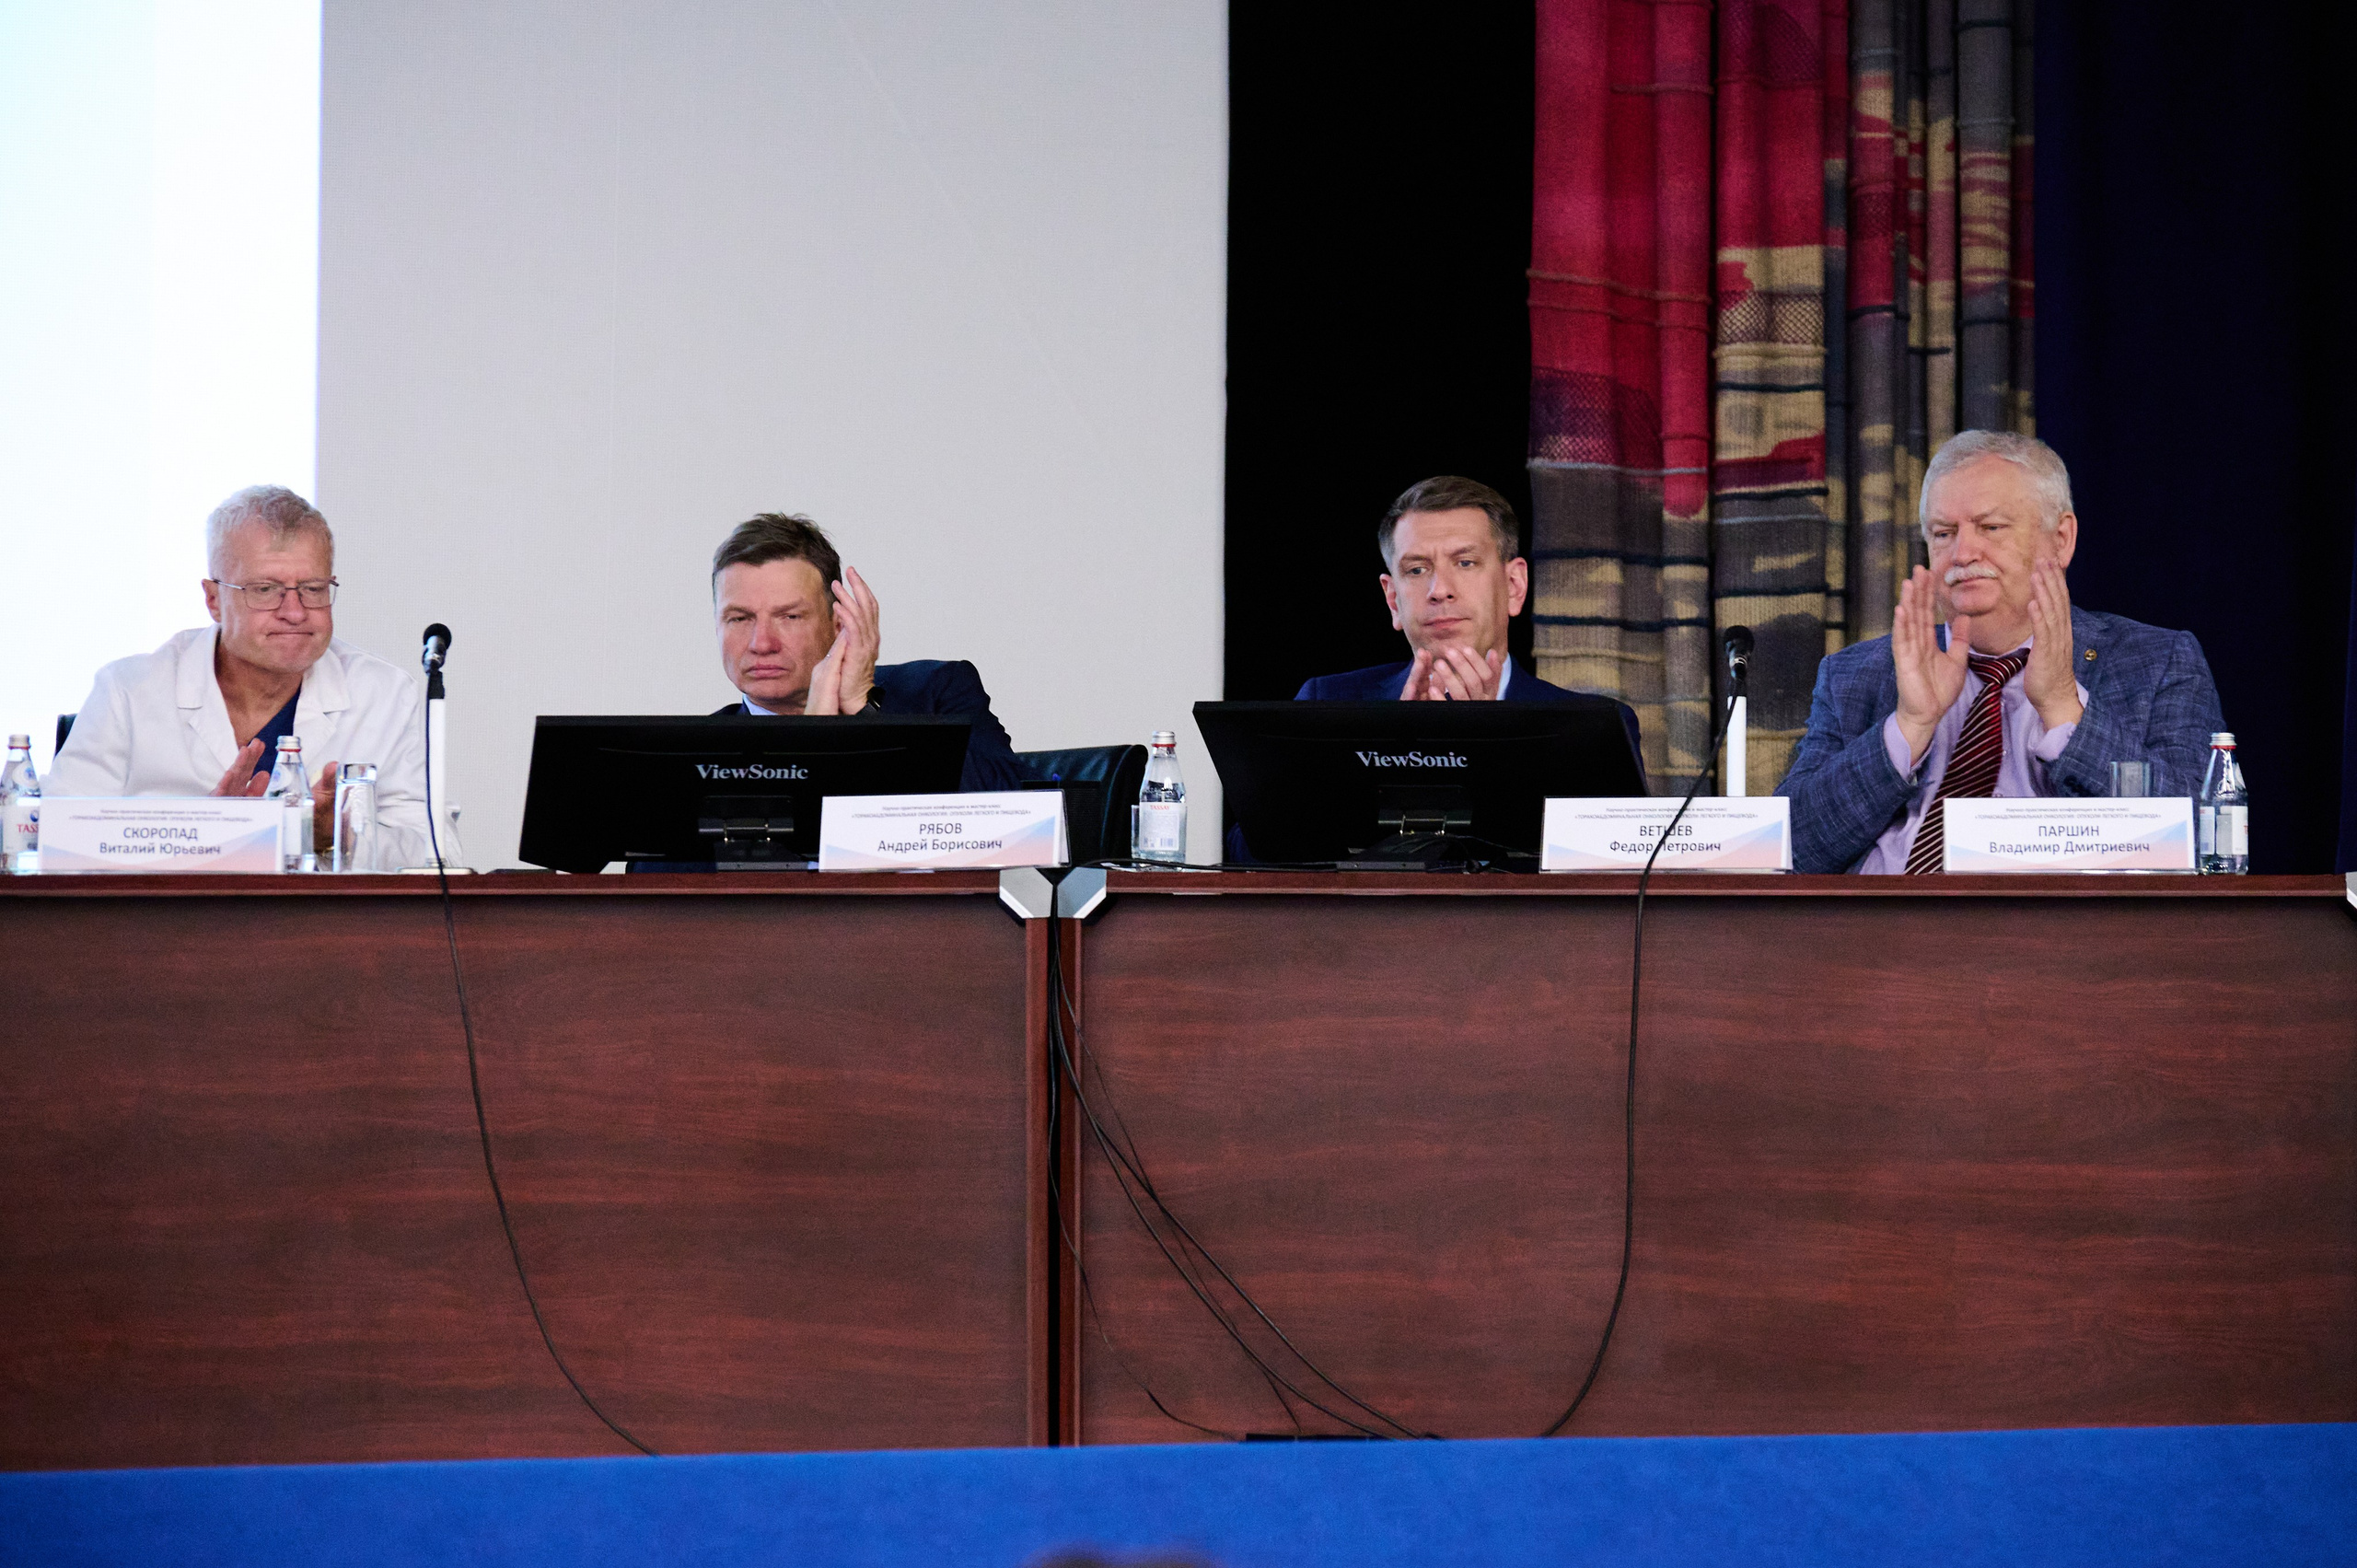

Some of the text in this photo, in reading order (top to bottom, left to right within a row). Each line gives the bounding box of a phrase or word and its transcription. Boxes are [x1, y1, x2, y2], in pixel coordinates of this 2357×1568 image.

[1355, 750, 1469, 767] ViewSonic
[695, 763, 808, 779] ViewSonic
[17, 823, 39, 833] TASS
[123, 827, 198, 841] СКОРОПАД
[919, 822, 962, 835] РЯБОВ
[2038, 825, 2100, 837] ПАРШИН
[99, 842, 221, 856] Виталий Юрьевич
[877, 838, 1003, 854] Андрей Борисович
[1609, 841, 1654, 854] Федор
[1990, 841, 2150, 855] Владимир Дмитриевич
